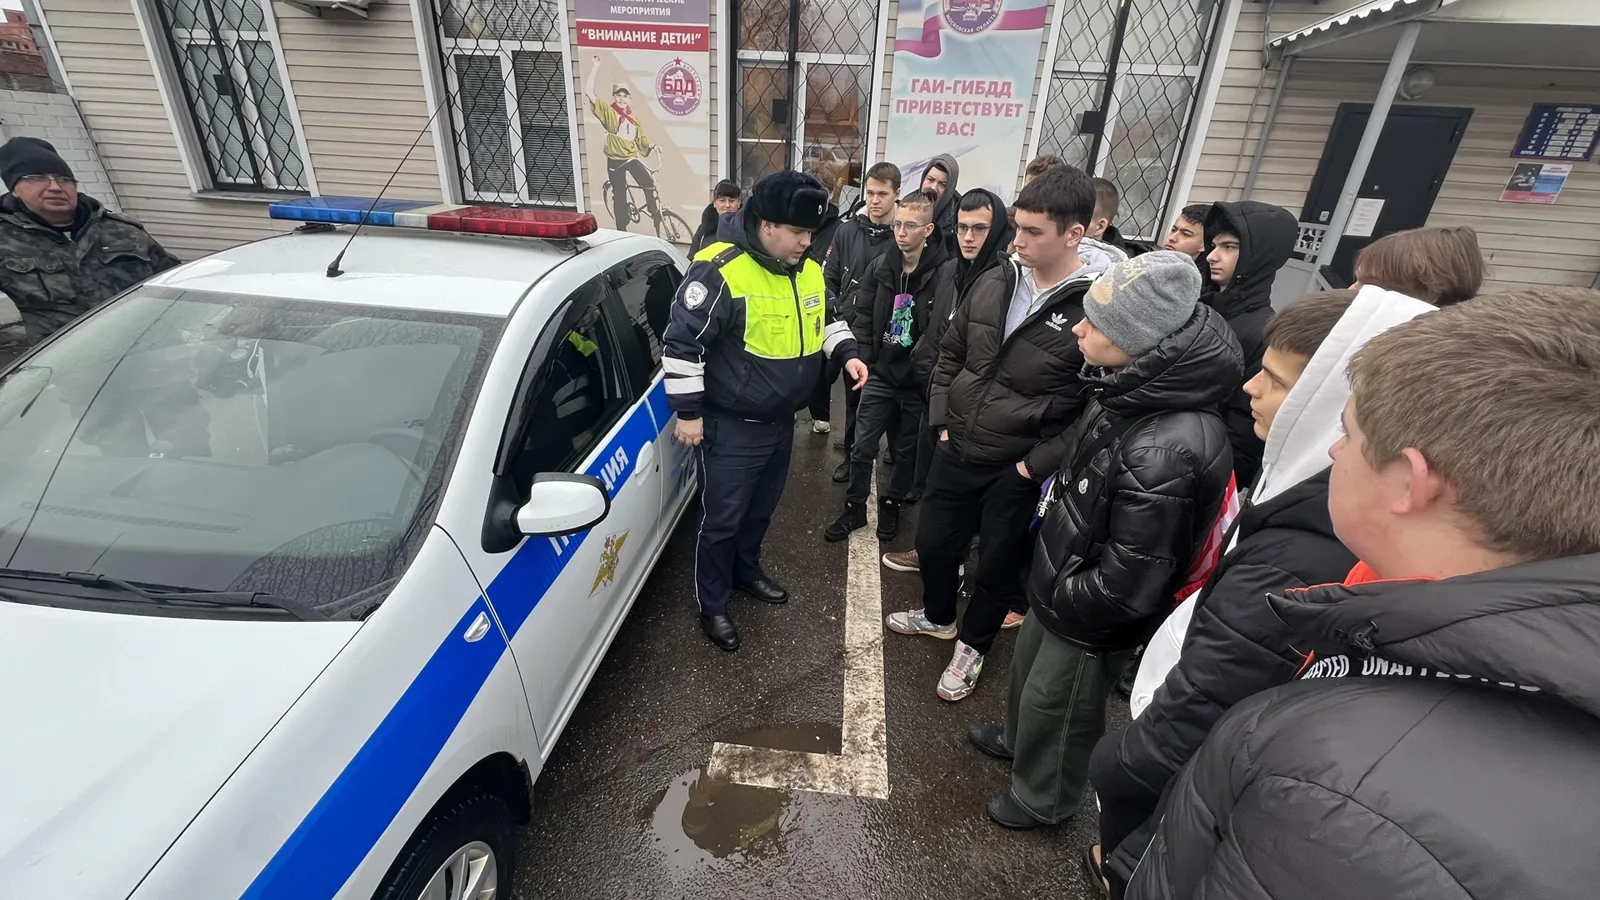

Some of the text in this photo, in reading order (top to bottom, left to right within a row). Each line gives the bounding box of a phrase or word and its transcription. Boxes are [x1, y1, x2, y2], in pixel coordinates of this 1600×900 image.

[610, 6, 671, 16] МЕРОПРИЯТИЯ
[946, 13, 997, 33] МОСКОВСКАЯ ОБЛАСТЬ
[663, 78, 695, 96] БДД
[911, 78, 1012, 98] ГАИ-ГИБДД
[895, 100, 1023, 118] ПРИВЕТСТВУЕТ
[936, 121, 976, 137] ВАС!
